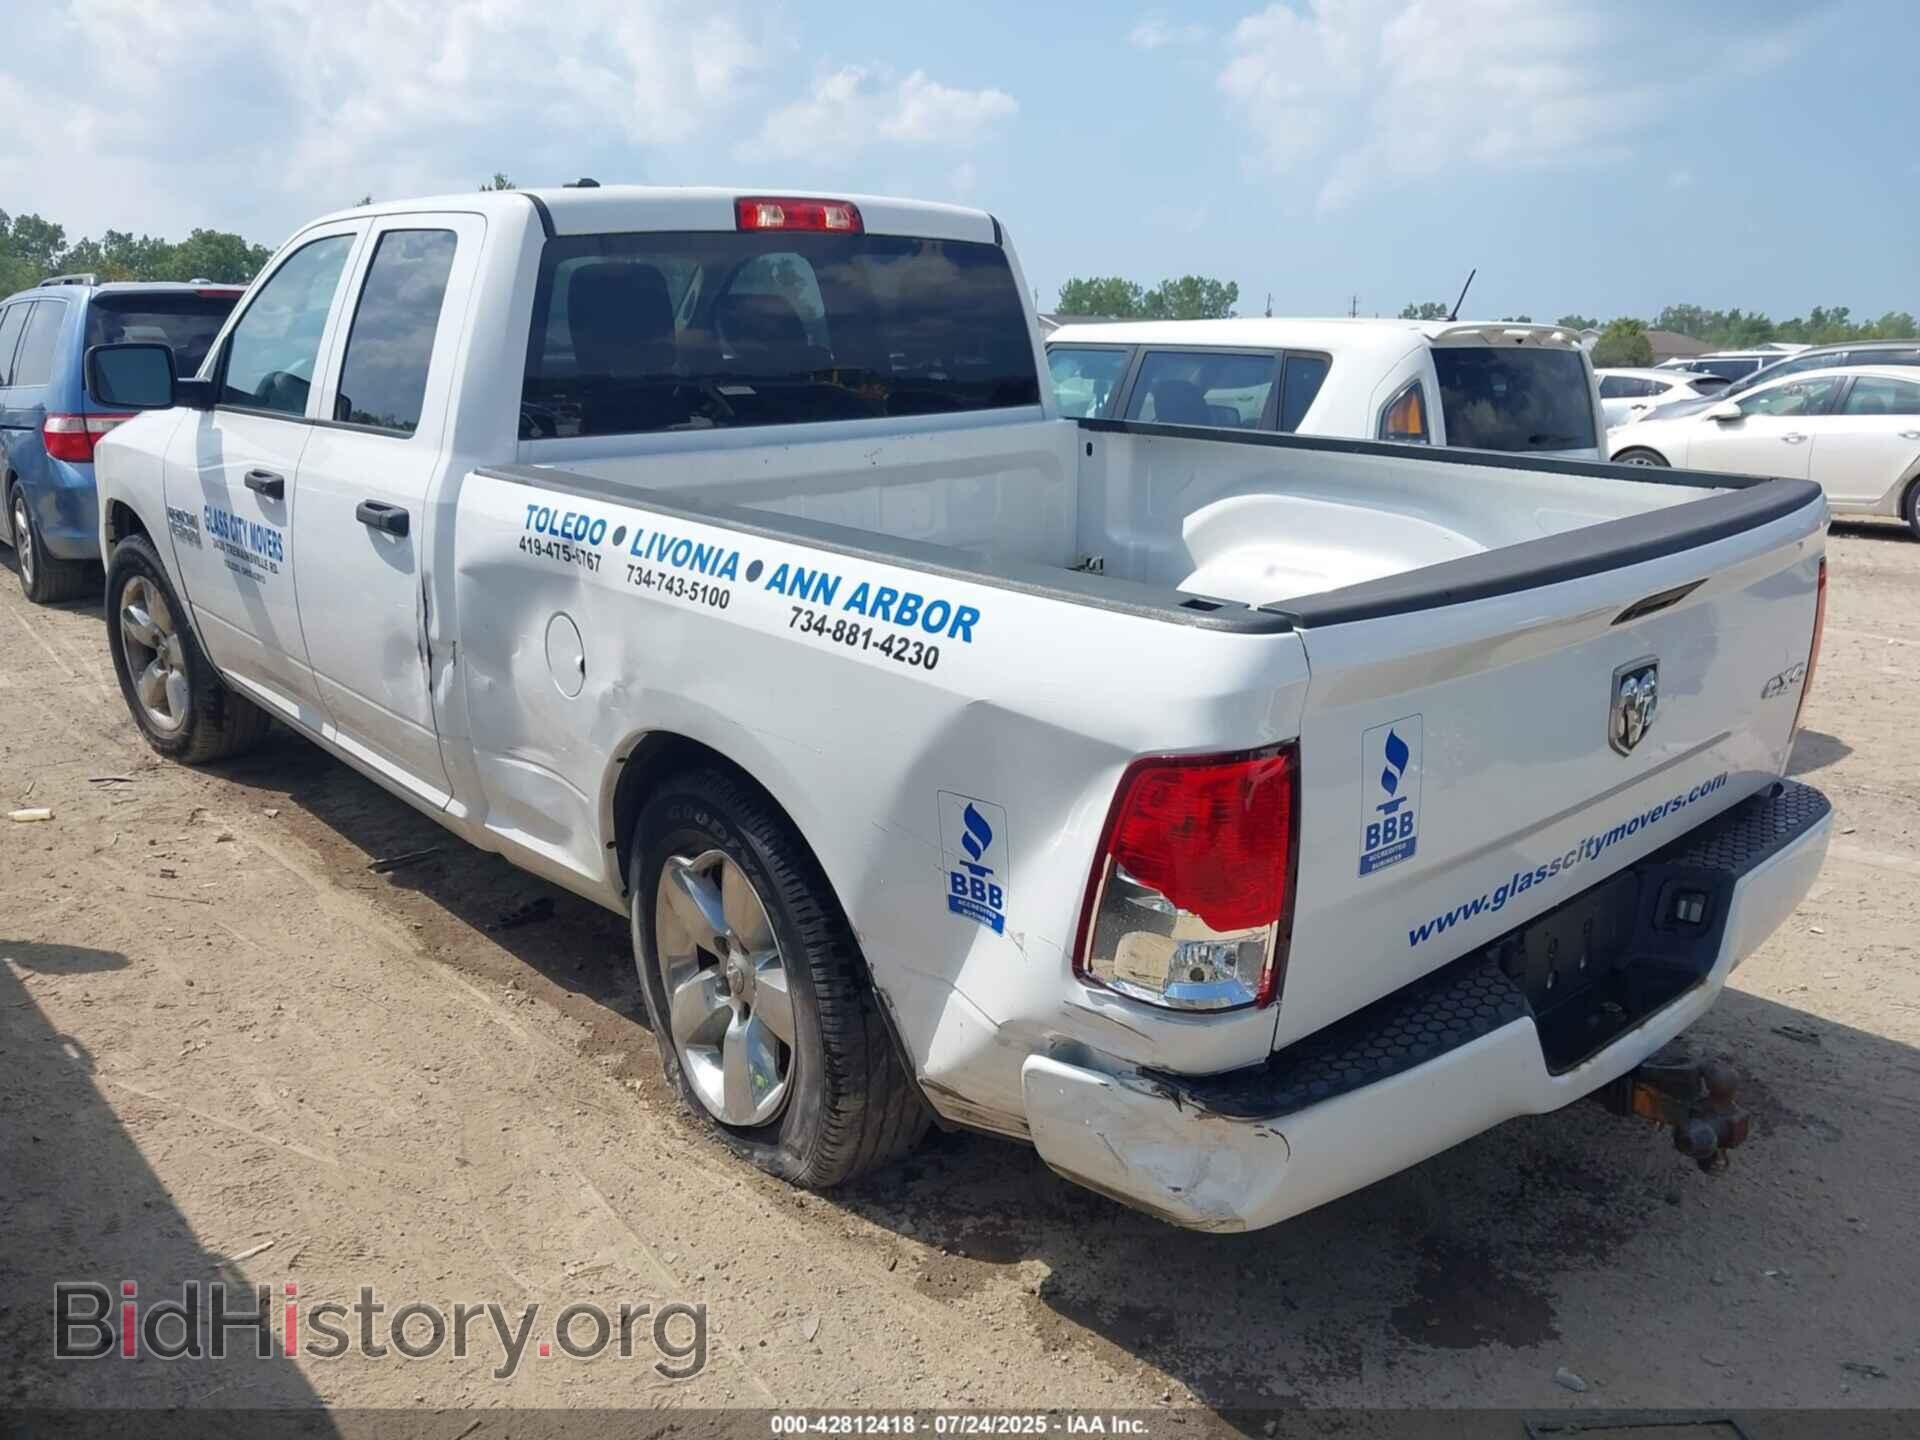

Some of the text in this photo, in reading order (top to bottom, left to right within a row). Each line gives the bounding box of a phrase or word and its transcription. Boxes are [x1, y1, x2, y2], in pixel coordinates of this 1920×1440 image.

[203, 504, 230, 540] GLASS
[230, 513, 248, 550] CITY
[249, 520, 283, 562] MOVERS
[519, 535, 602, 573] 419-475-6767
[525, 504, 980, 643] TOLEDO LIVONIA ANN ARBOR
[626, 564, 731, 609] 734-743-5100
[788, 606, 939, 670] 734-881-4230
[1366, 810, 1414, 851] BBB
[1408, 771, 1728, 948] www.glasscitymovers.com
[950, 871, 1003, 910] BBB
